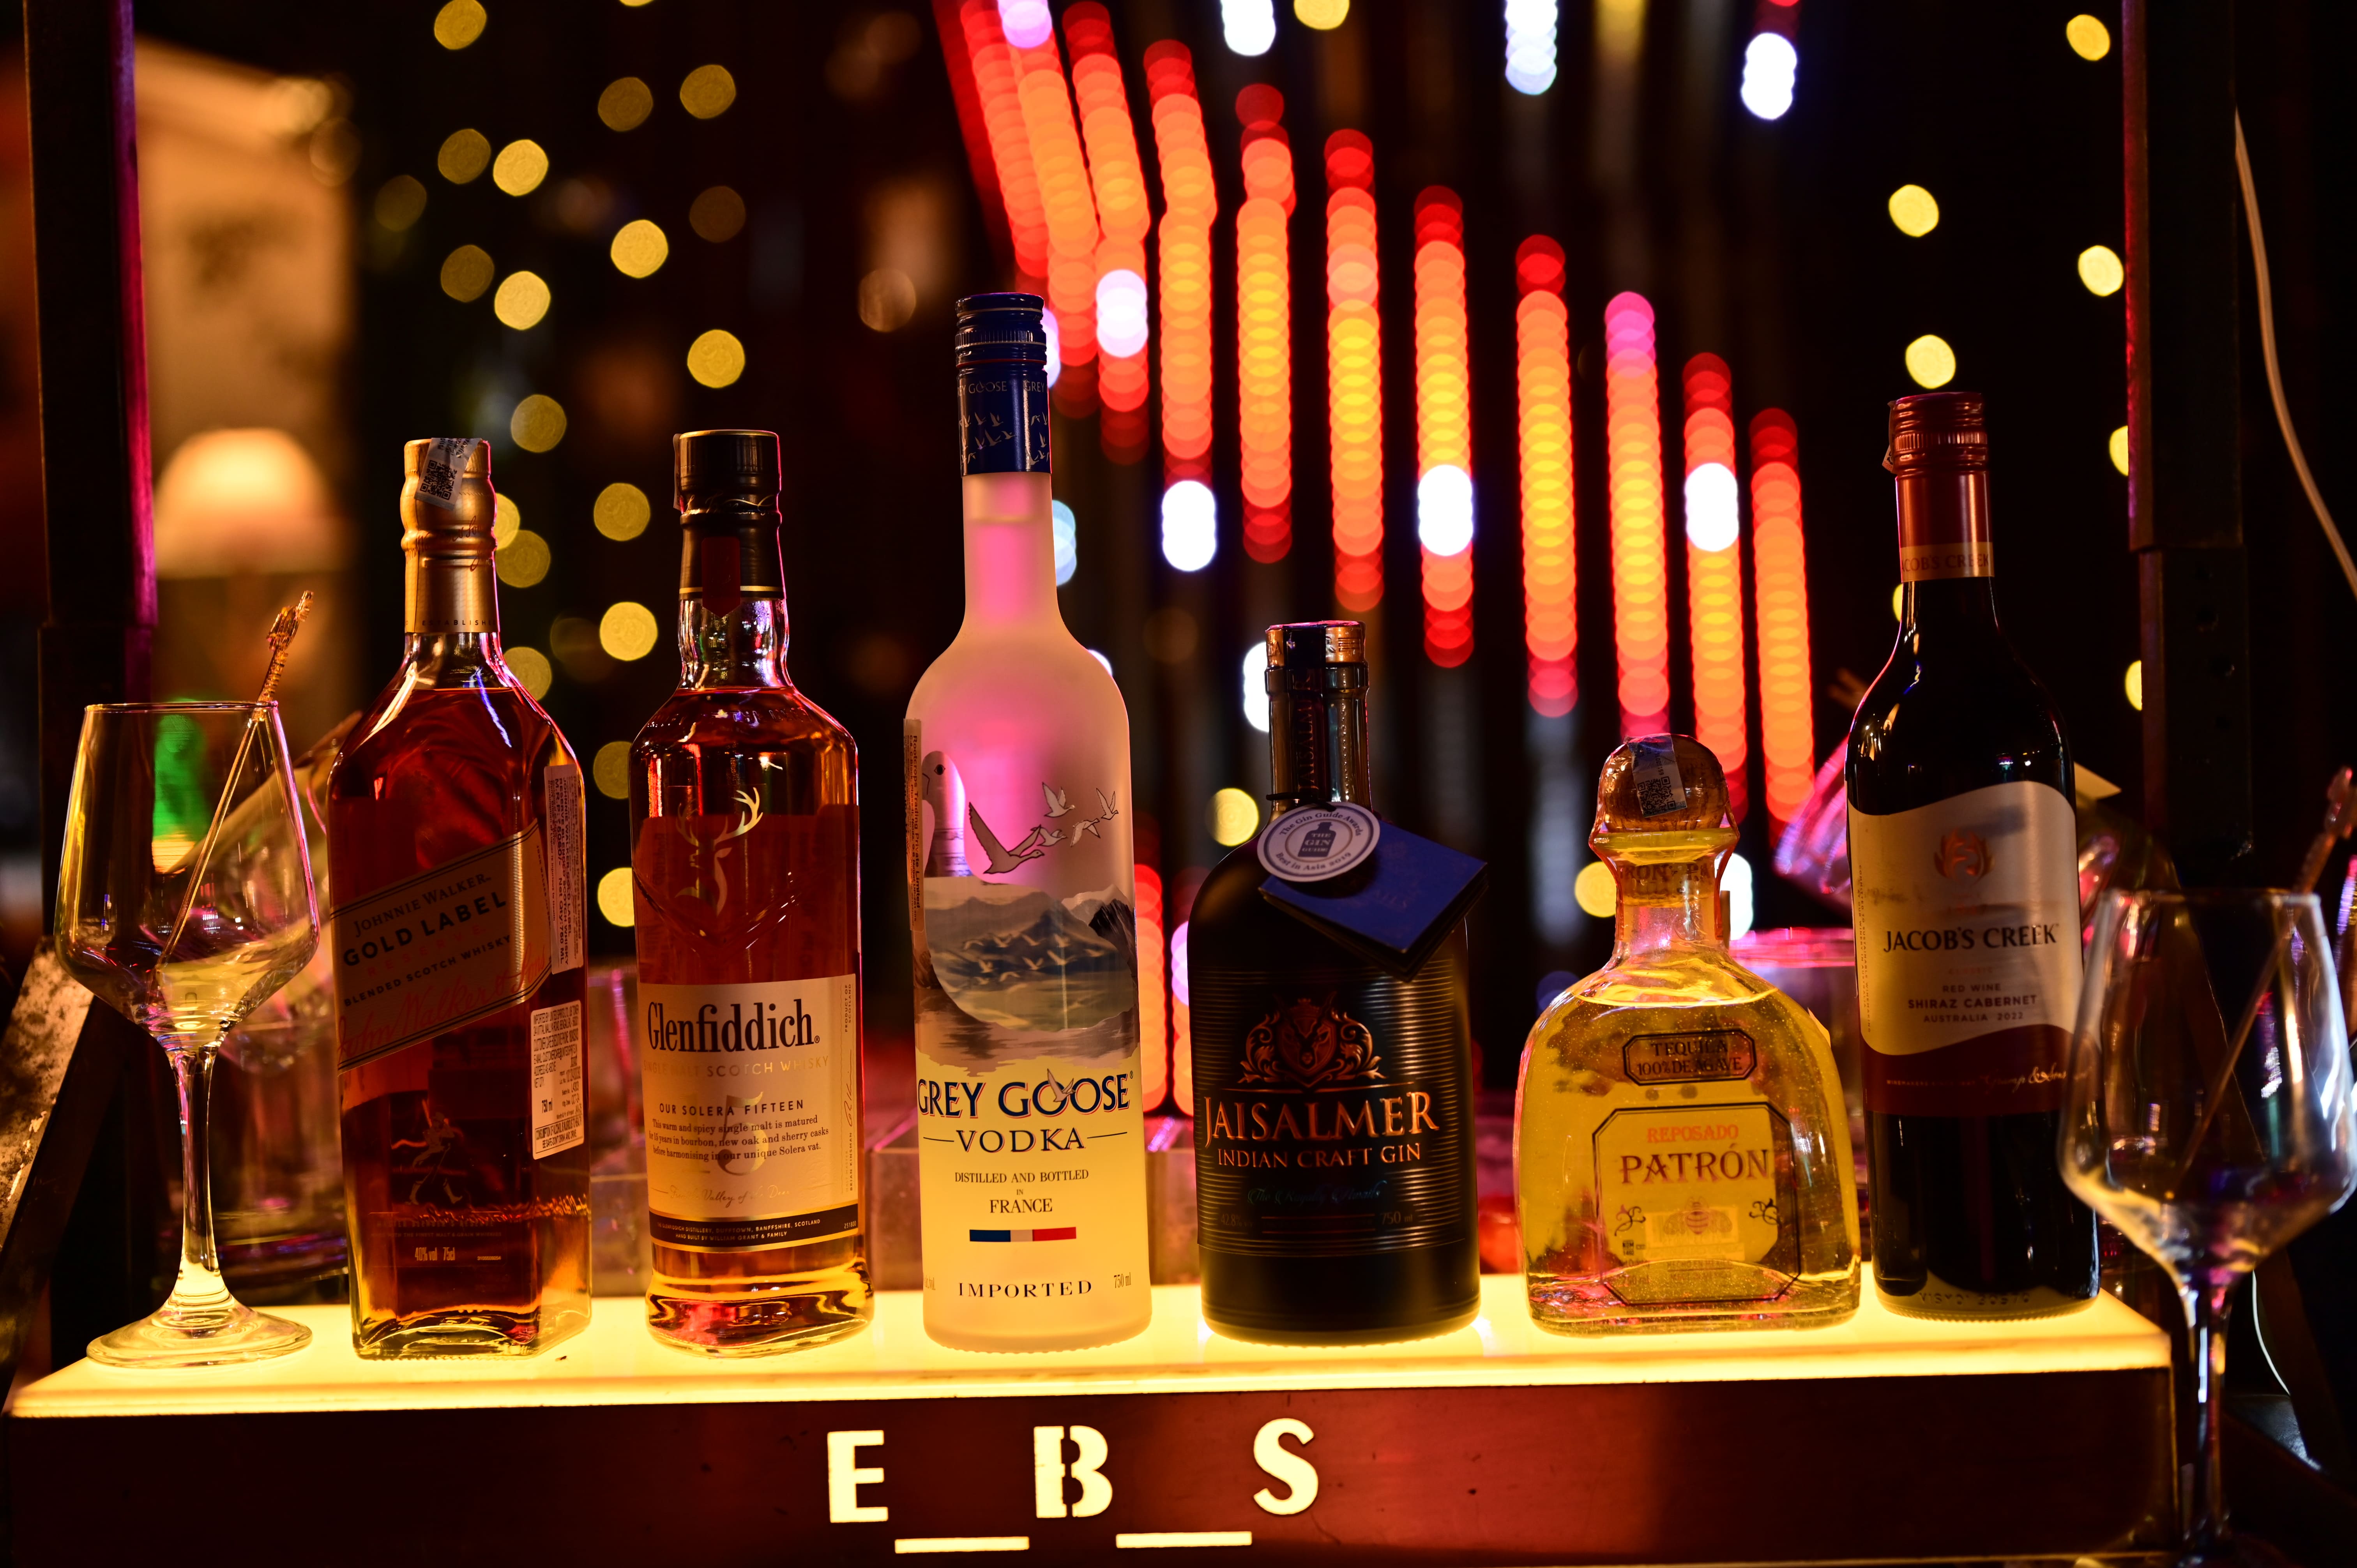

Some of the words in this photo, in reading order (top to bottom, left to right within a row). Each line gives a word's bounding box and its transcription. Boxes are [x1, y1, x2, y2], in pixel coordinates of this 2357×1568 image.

[1945, 553, 1989, 570] CREEK
[1279, 823, 1295, 835] The
[1295, 815, 1312, 825] Gin
[1343, 816, 1363, 836] Awards
[1276, 852, 1291, 866] Best
[1291, 862, 1301, 870] in
[354, 900, 421, 938] JOHNNIE
[343, 927, 413, 967] GOLD
[421, 891, 507, 936] LABEL
[1883, 926, 1975, 952] JACOB'S
[1982, 924, 2057, 949] CREEK
[368, 924, 486, 977] RESERVE
[560, 948, 564, 964] ML
[345, 978, 402, 1007] BLENDED
[406, 956, 457, 982] SCOTCH
[461, 935, 511, 960] WHISKY
[845, 984, 848, 994] OF
[1942, 985, 1965, 993] RED
[1970, 983, 2001, 992] WINE
[1908, 999, 1957, 1009] SHIRAZ
[1964, 995, 2037, 1008] CABERNET
[1924, 1014, 1988, 1023] AUSTRALIA
[1997, 1012, 2023, 1021] 2022
[1651, 1040, 1729, 1056] TEQUILA
[707, 1062, 773, 1077] SCOTCH
[780, 1055, 829, 1072] WHISKY
[1637, 1060, 1671, 1075] 100%
[1671, 1059, 1691, 1074] DE
[1694, 1057, 1742, 1072] AGAVE
[659, 1103, 676, 1114] OUR
[682, 1106, 735, 1116] SOLERA
[745, 1100, 804, 1115] FIFTEEN
[918, 1079, 986, 1119] GREY
[652, 1118, 661, 1129] This
[663, 1123, 677, 1131] warm
[678, 1123, 691, 1132] and
[693, 1124, 716, 1135] spicy
[718, 1124, 749, 1134] single
[751, 1121, 772, 1131] malt
[775, 1120, 783, 1129] is
[784, 1114, 818, 1127] matured
[1203, 1091, 1440, 1148] JAISALMER
[659, 1135, 672, 1144] years
[673, 1135, 680, 1144] in
[681, 1137, 717, 1148] bourbon,
[741, 1137, 759, 1146] oak
[762, 1133, 779, 1144] and
[781, 1129, 808, 1142] sherry
[810, 1127, 829, 1138] casks
[956, 1128, 1086, 1153] VODKA
[1647, 1125, 1739, 1143] REPOSADO
[653, 1144, 666, 1156] before
[666, 1146, 709, 1162] harmonising
[711, 1151, 721, 1161] in
[723, 1152, 741, 1161] our
[744, 1150, 777, 1160] unique
[779, 1145, 806, 1156] Solera
[807, 1142, 821, 1152] vat.
[1217, 1148, 1288, 1169] INDIAN
[1297, 1147, 1373, 1169] CRAFT
[1380, 1142, 1422, 1164] GIN
[1620, 1143, 1770, 1185] PATRÓN
[954, 1172, 1007, 1183] DISTILLED
[1011, 1172, 1035, 1183] AND
[1040, 1169, 1089, 1182] BOTTLED
[703, 1189, 736, 1208] Valley
[989, 1198, 1053, 1213] FRANCE
[755, 1223, 793, 1232] BANFFSHIRE,
[795, 1218, 821, 1227] SCOTLAND
[1380, 1211, 1402, 1225] 750
[1404, 1214, 1413, 1223] ml
[958, 1280, 1092, 1298] IMPORTED
[1113, 1274, 1124, 1289] 750
[1125, 1272, 1131, 1286] ml
